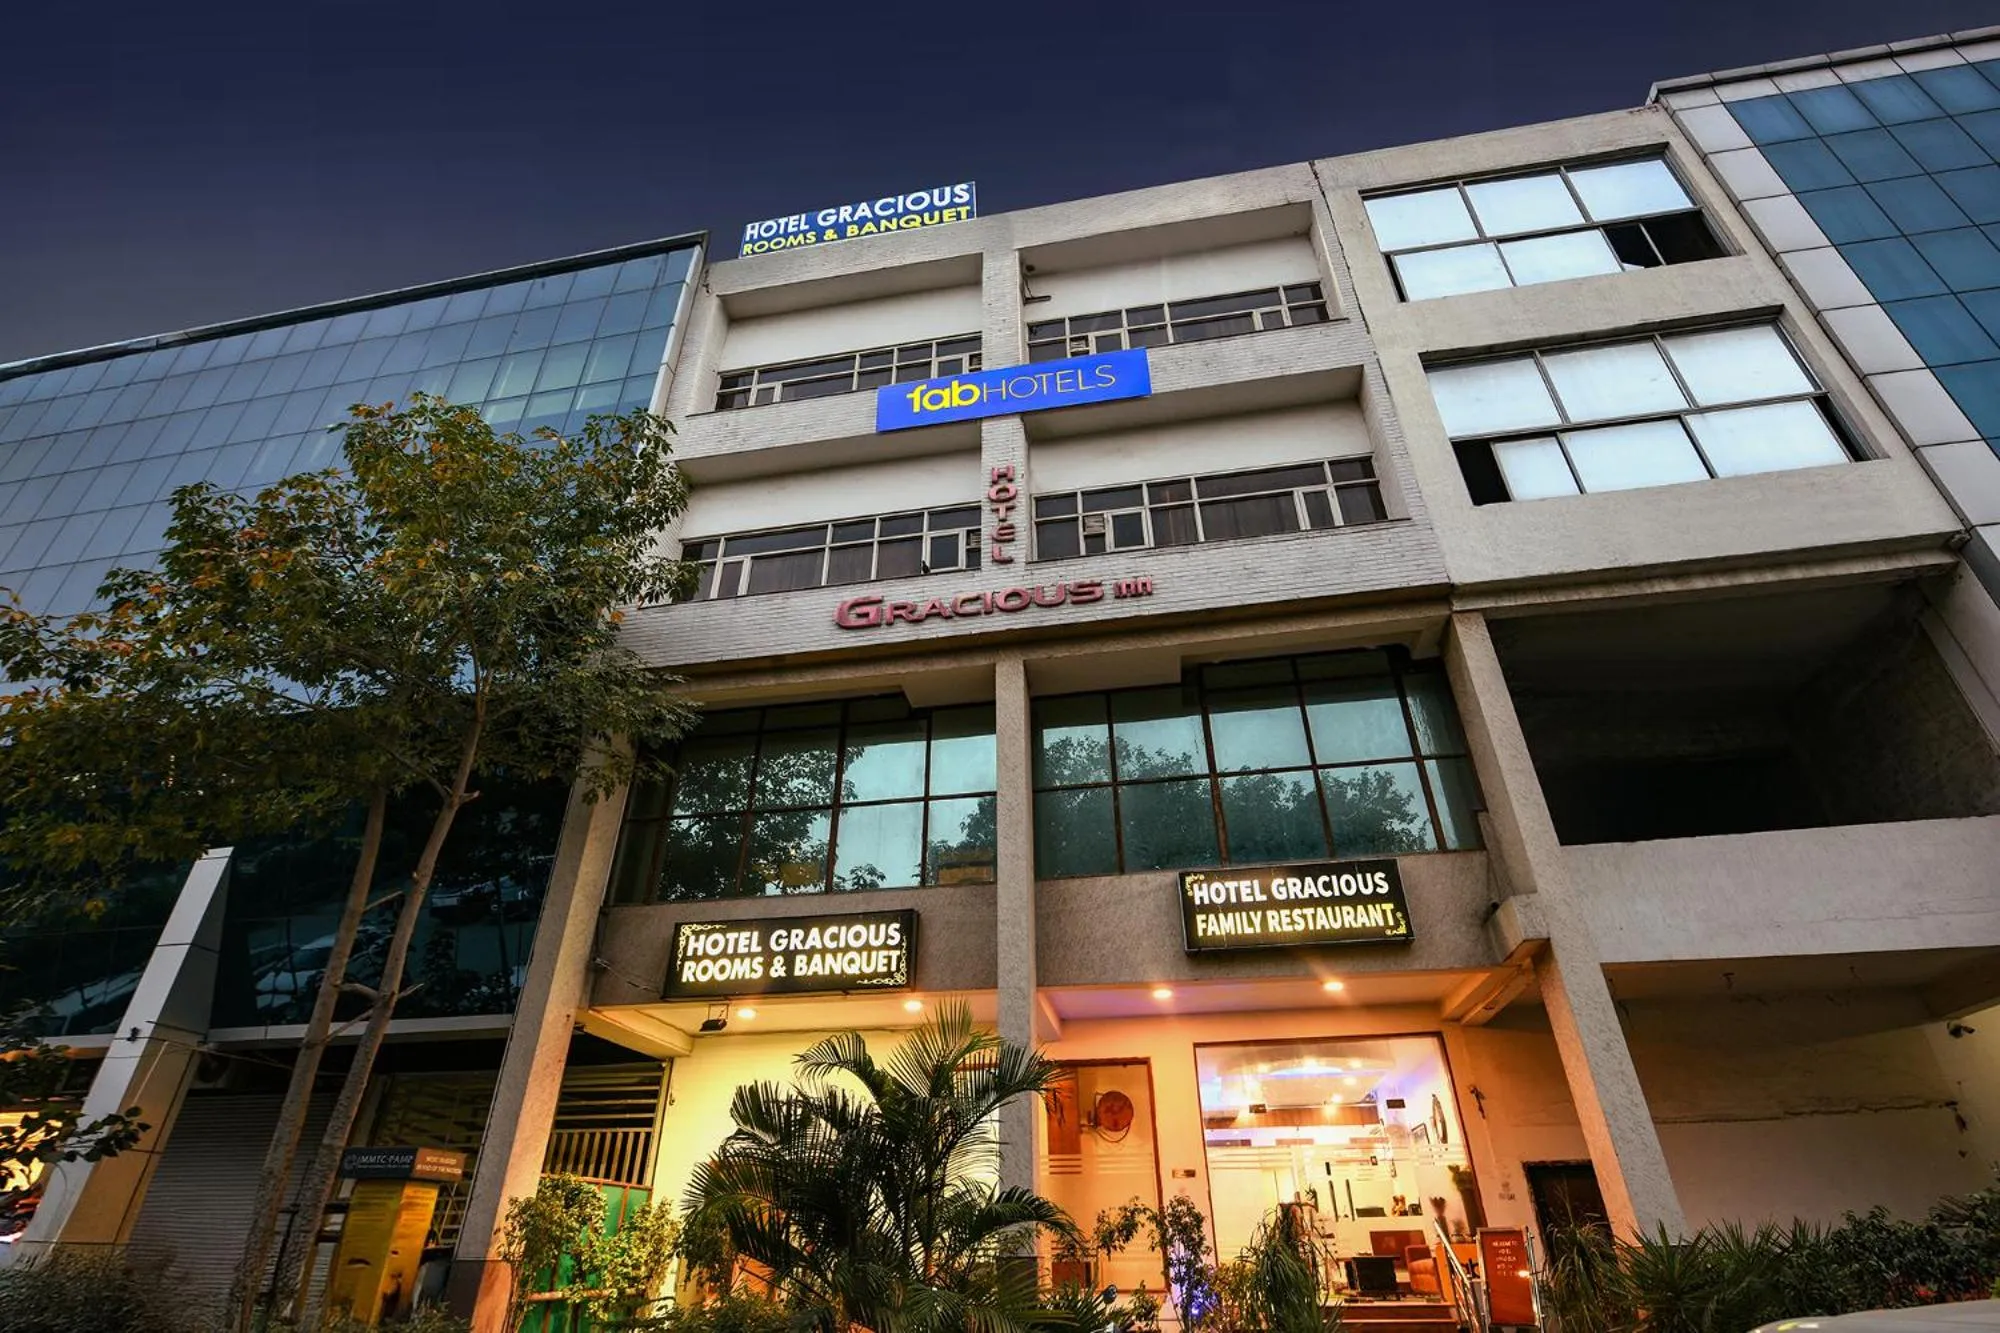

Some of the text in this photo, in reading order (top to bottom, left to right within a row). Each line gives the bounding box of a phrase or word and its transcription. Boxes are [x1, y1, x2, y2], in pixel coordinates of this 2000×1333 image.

[742, 206, 971, 255] ROOMS & BANQUET
[745, 183, 971, 242] HOTEL GRACIOUS
[987, 463, 1018, 565] HOTEL
[833, 580, 1105, 629] GRACIOUS
[1193, 871, 1390, 906] HOTEL GRACIOUS
[686, 922, 902, 957] HOTEL GRACIOUS
[1196, 903, 1395, 937] FAMILY RESTAURANT
[681, 950, 901, 983] ROOMS & BANQUET
